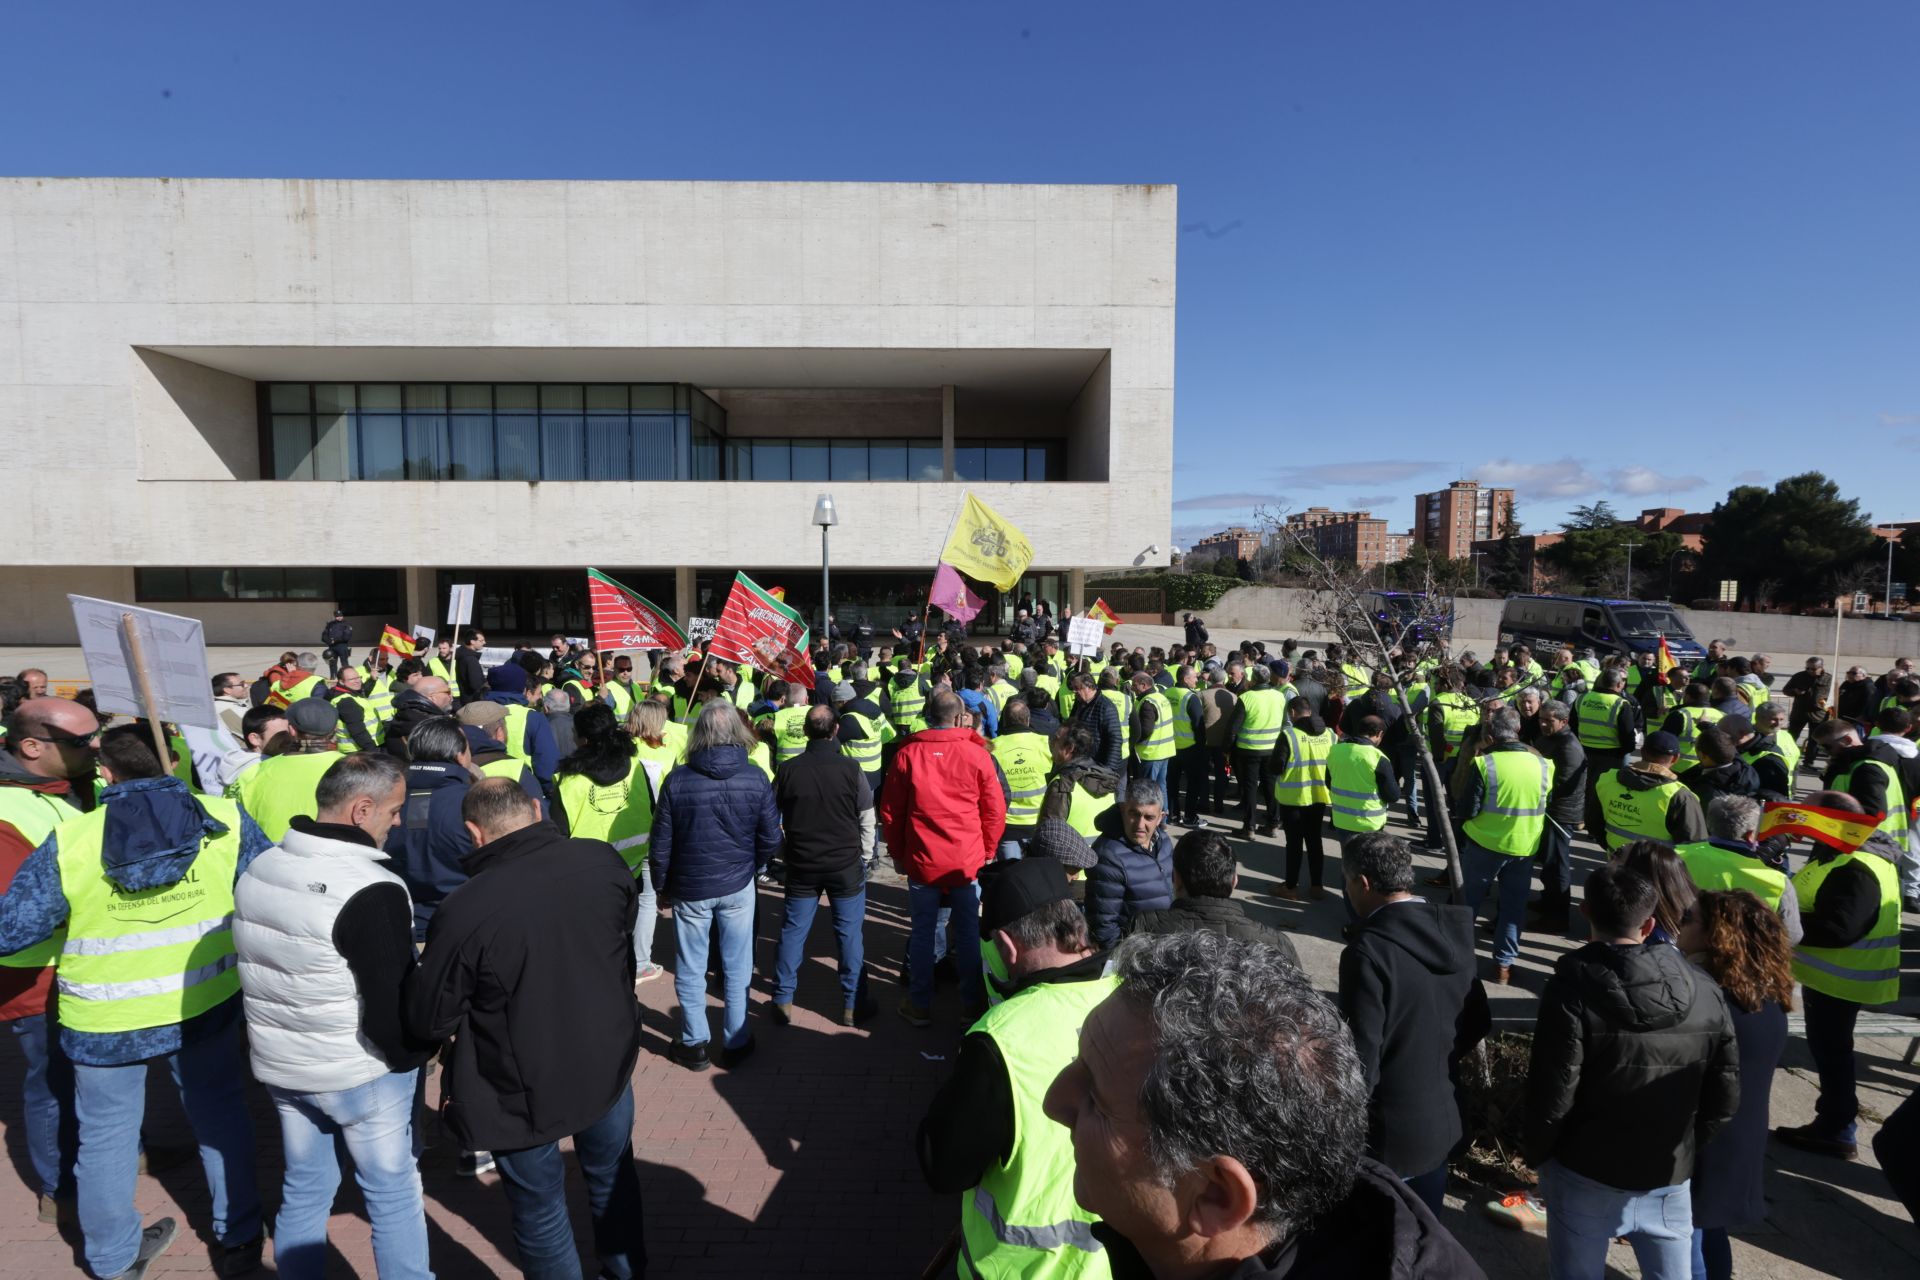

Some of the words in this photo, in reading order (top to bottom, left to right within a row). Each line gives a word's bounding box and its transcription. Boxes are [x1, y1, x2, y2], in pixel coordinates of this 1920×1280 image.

[107, 903, 117, 911] EN
[118, 900, 145, 911] DEFENSA
[147, 897, 160, 905] DEL
[161, 892, 187, 903] MUNDO
[187, 888, 206, 899] RURAL
